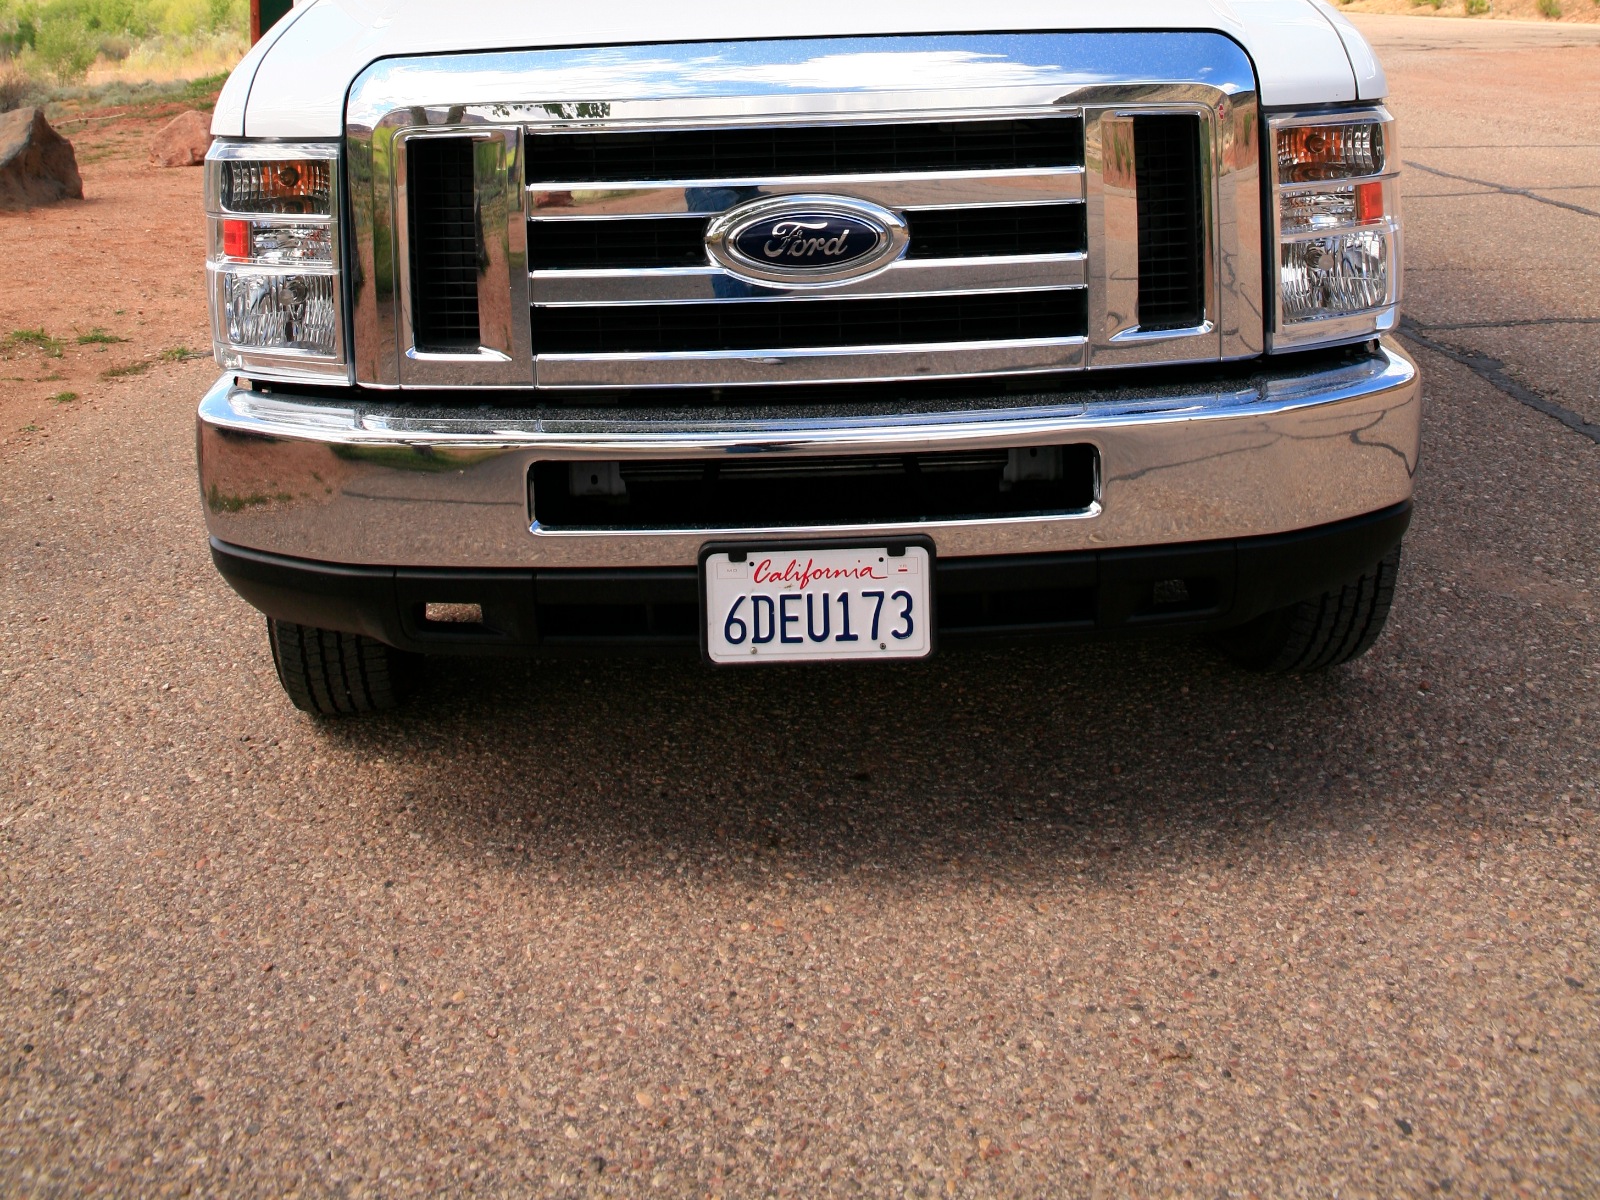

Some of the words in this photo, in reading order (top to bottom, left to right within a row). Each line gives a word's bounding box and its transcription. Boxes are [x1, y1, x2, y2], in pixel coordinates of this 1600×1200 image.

[764, 221, 850, 258] Ford
[753, 558, 888, 589] California
[724, 590, 914, 644] 6DEU173
